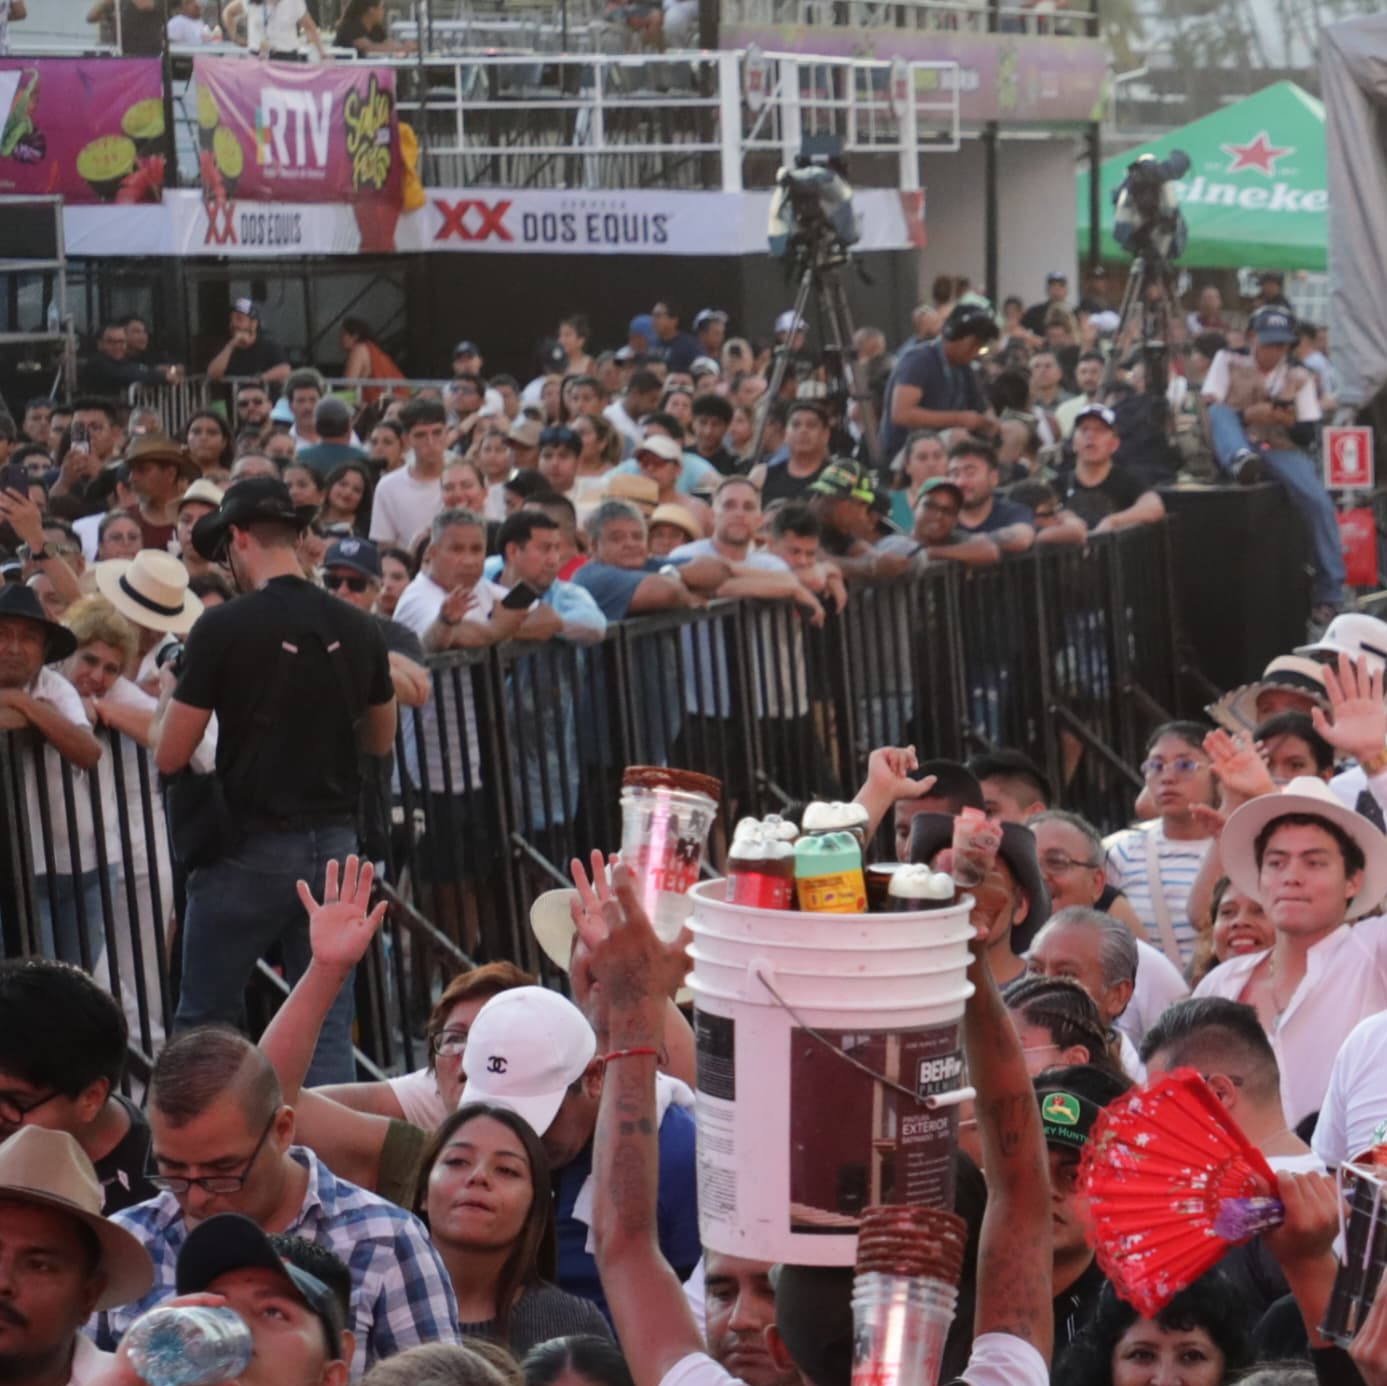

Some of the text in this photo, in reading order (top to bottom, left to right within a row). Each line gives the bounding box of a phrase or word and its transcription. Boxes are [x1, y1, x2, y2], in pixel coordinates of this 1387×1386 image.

[261, 87, 332, 167] RTV
[204, 203, 302, 245] XX DOS EQUIS
[433, 200, 669, 244] XX DOS EQUIS
